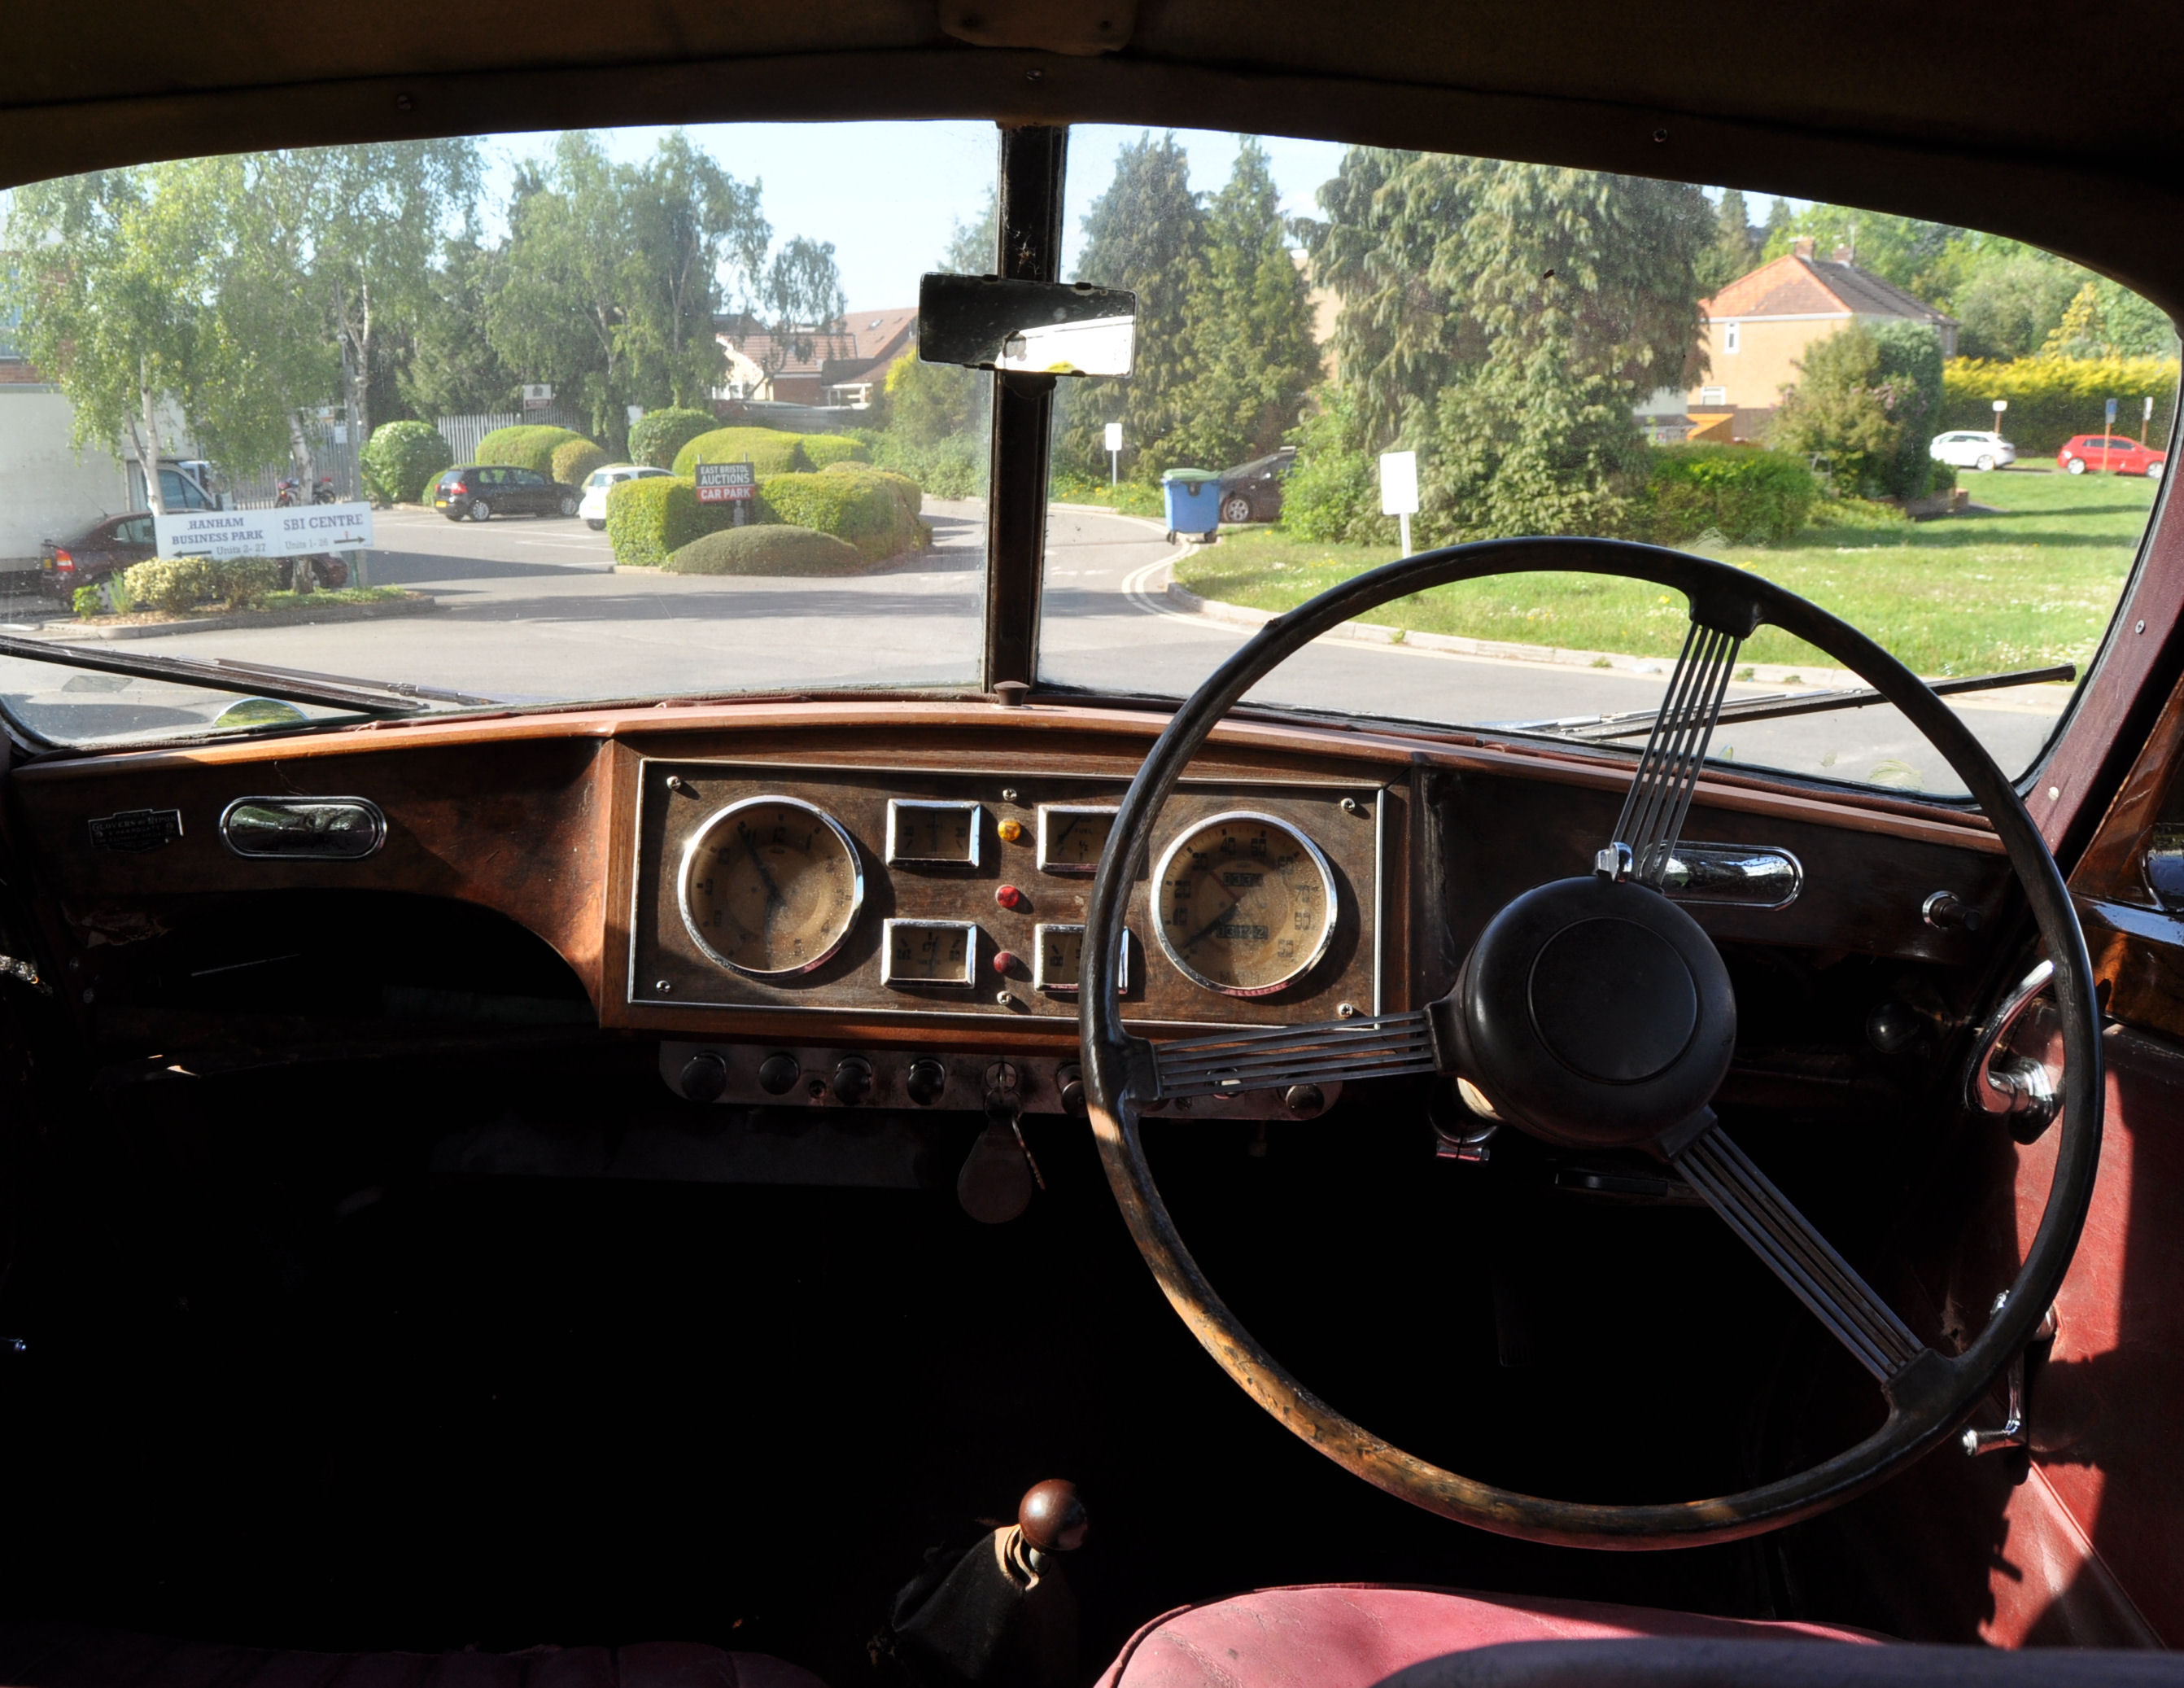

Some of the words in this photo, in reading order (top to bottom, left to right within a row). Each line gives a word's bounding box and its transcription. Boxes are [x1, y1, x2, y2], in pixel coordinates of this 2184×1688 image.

[701, 466, 718, 474] EAST
[719, 465, 749, 474] BRISTOL
[701, 474, 749, 486] AUCTIONS
[701, 489, 722, 500] CAR
[723, 488, 751, 498] PARK
[188, 518, 244, 530] HANHAM
[283, 518, 305, 531] SBI
[309, 514, 364, 529] CENTRE
[172, 532, 229, 545] BUSINESS
[231, 530, 264, 541] PARK
[216, 546, 241, 555] Units
[285, 540, 306, 550] Units
[1220, 837, 1236, 855] 40
[1251, 837, 1267, 857] 50
[1192, 852, 1208, 871] 30
